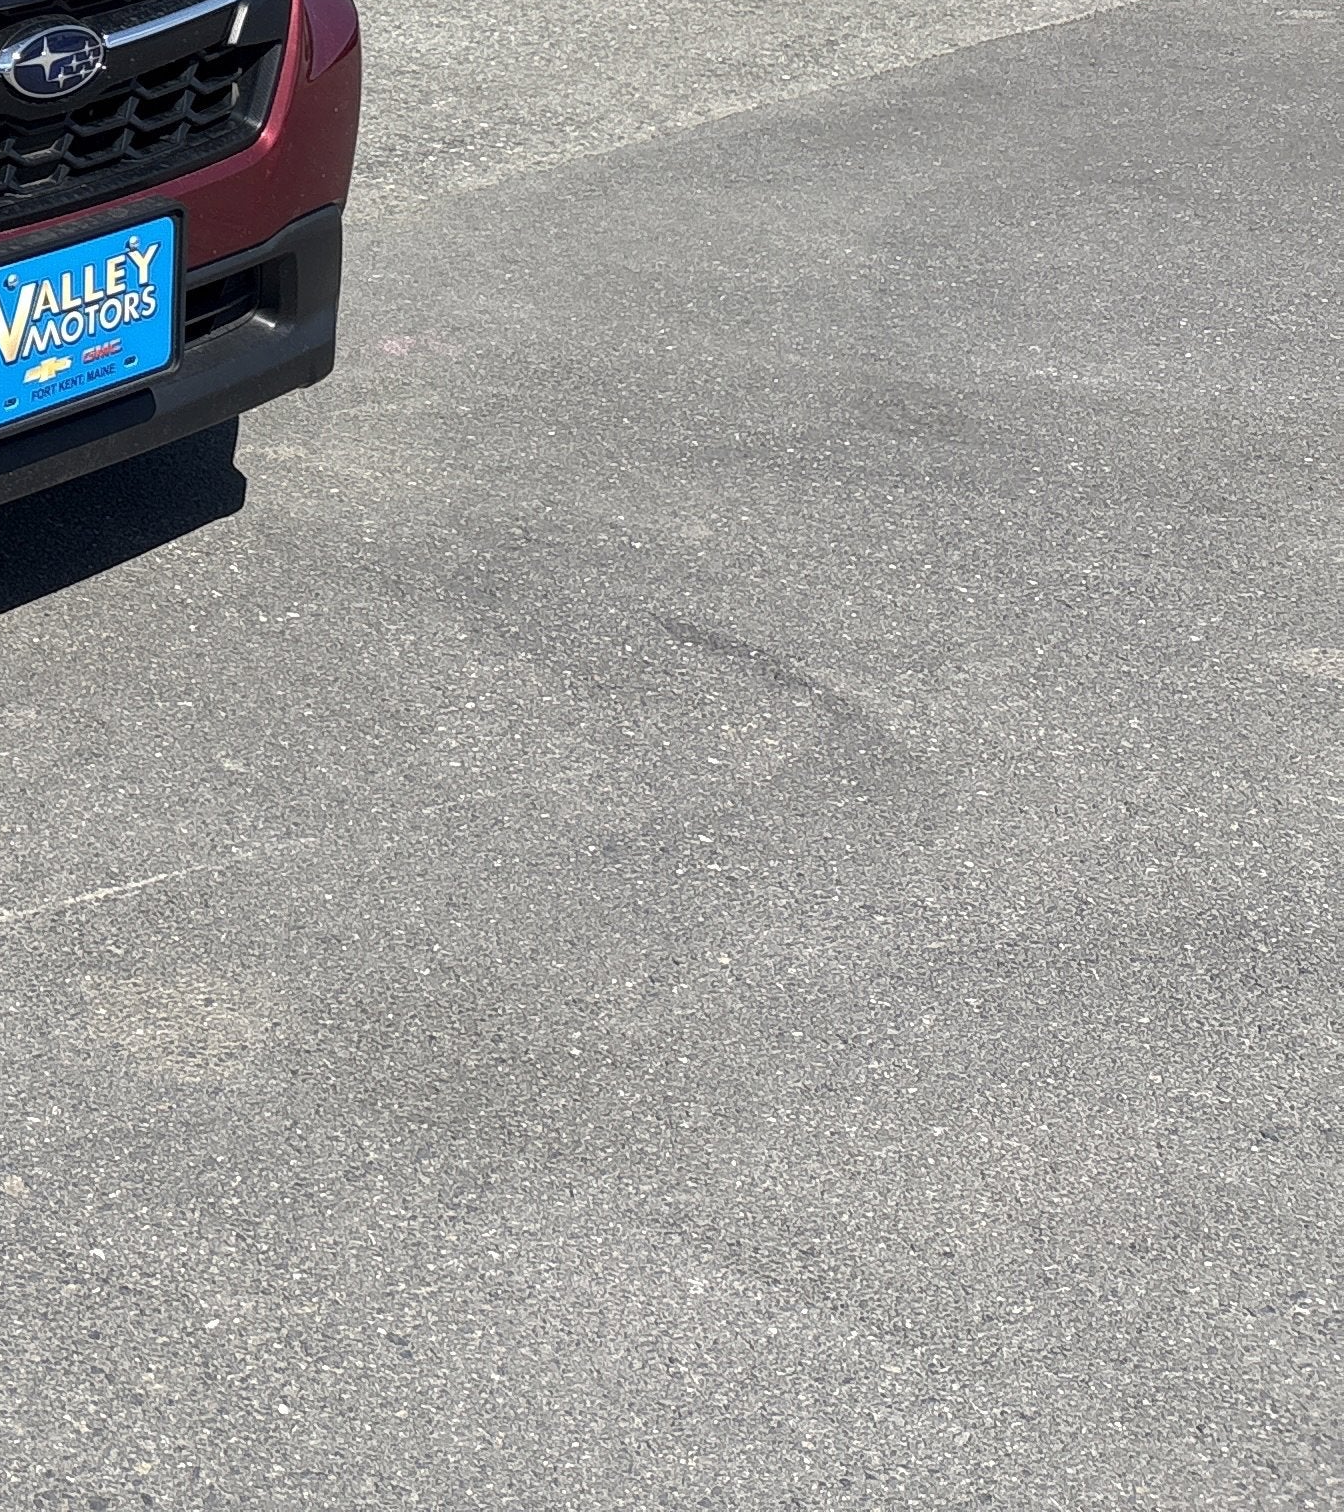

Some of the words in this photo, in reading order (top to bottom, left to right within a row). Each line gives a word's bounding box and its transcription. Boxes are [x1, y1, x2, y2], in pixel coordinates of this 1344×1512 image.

[21, 285, 157, 359] MOTORS
[81, 338, 122, 364] GMC
[31, 384, 58, 402] FORT
[87, 362, 117, 382] MAINE
